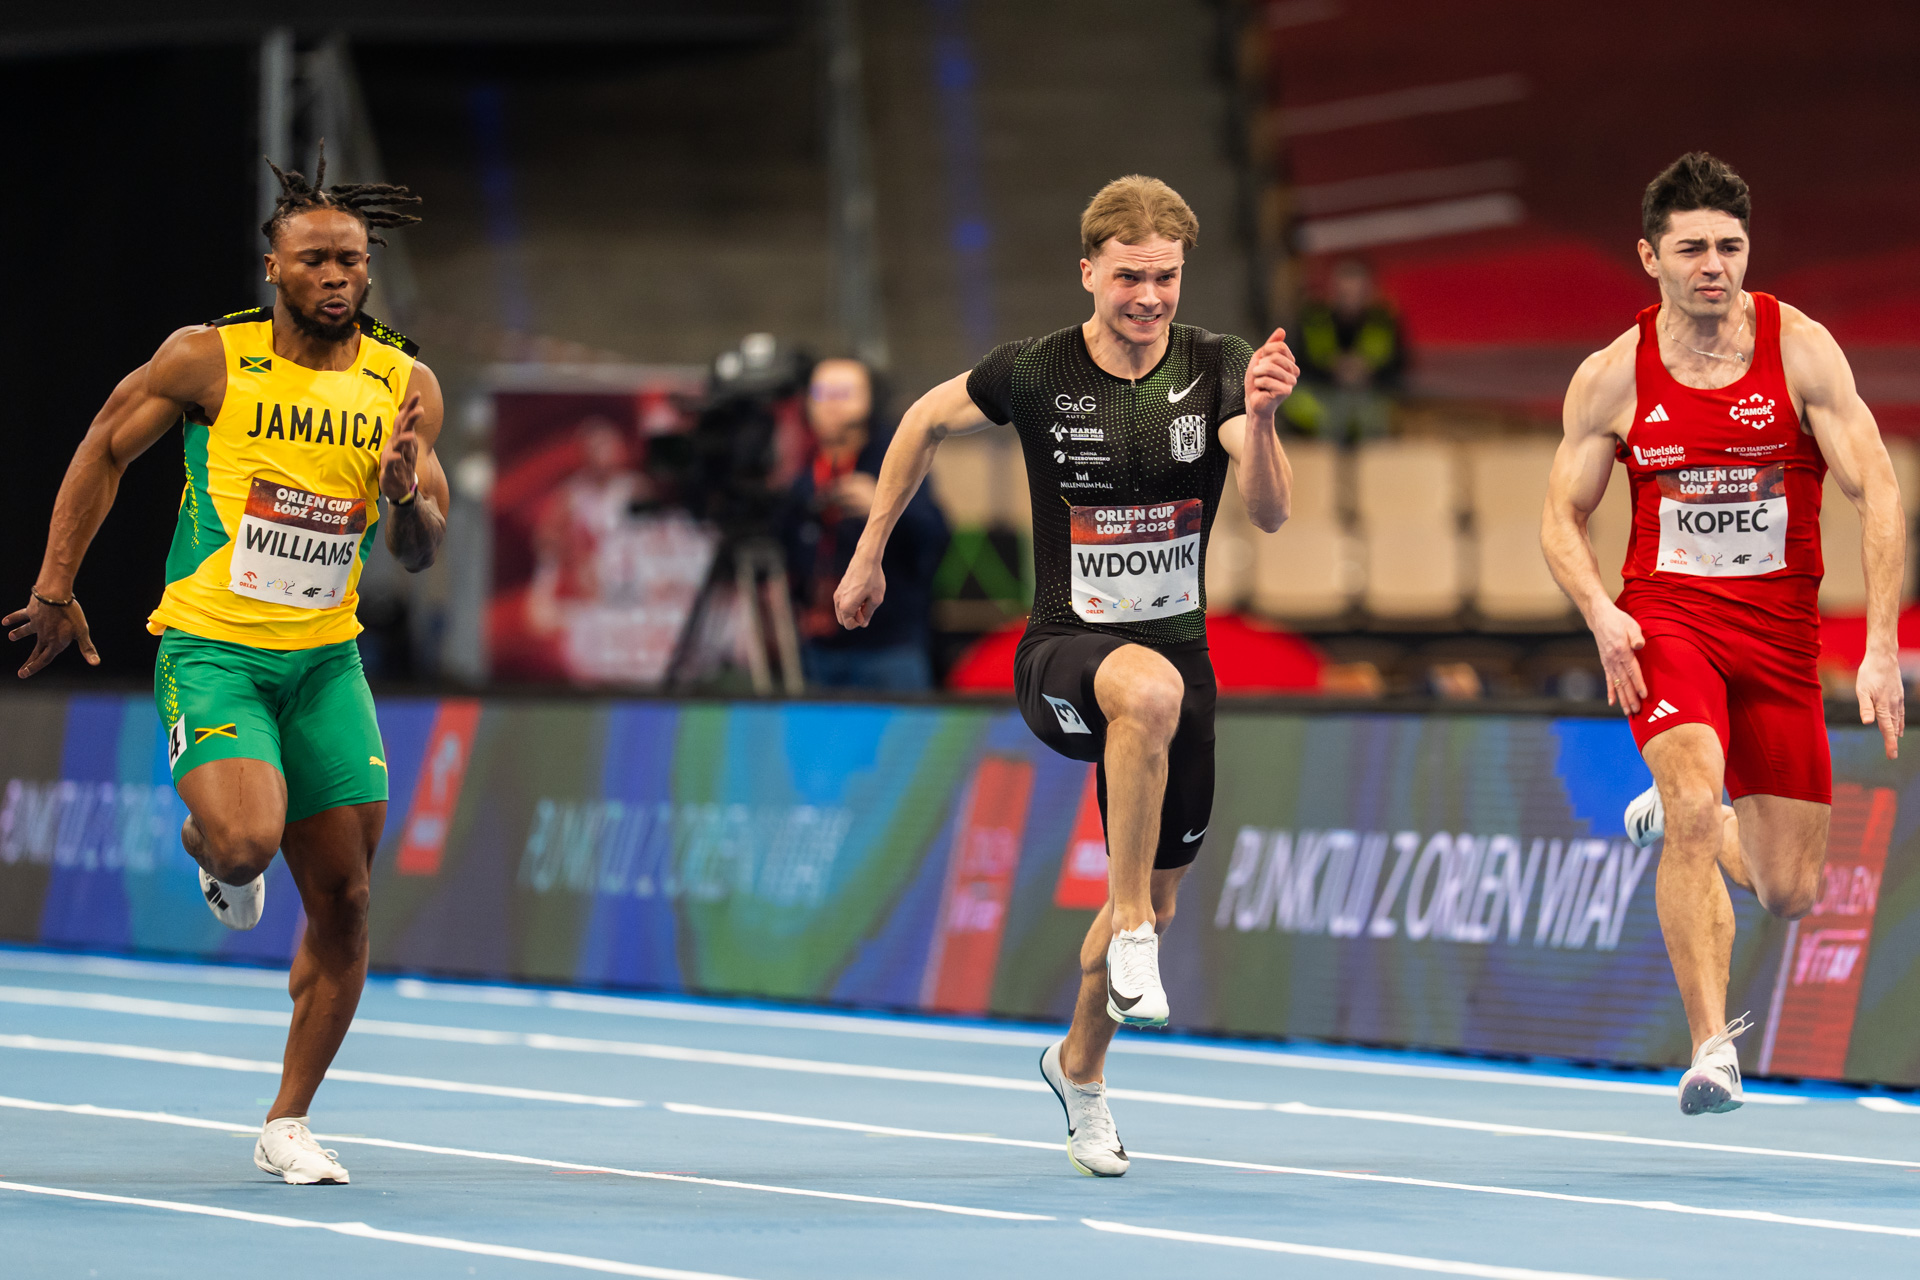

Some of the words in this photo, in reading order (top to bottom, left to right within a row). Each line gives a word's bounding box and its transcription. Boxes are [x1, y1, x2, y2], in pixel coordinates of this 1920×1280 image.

[1055, 394, 1097, 412] G&G
[1739, 405, 1773, 416] ZAMOŚĆ
[247, 402, 383, 451] JAMAICA
[1747, 444, 1777, 452] HARPOON
[1678, 469, 1726, 483] ORLEN
[1729, 468, 1757, 480] CUP
[1718, 482, 1758, 494] 2026
[276, 488, 326, 509] ORLEN
[327, 499, 352, 513] CUP
[311, 511, 349, 525] 2026
[1094, 509, 1146, 522] ORLEN
[1148, 505, 1176, 519] CUP
[1677, 502, 1769, 534] KOPEĆ
[1136, 520, 1176, 533] 2026
[246, 523, 355, 566] WILLIAMS
[1077, 541, 1195, 578] WDOWIK
[1732, 554, 1752, 565] 4F
[239, 581, 258, 590] ORLEN
[302, 587, 322, 598] 4F
[1151, 595, 1170, 607] 4F
[1054, 703, 1080, 724] 3
[171, 725, 180, 762] 4
[1405, 832, 1544, 946] ORLEN
[1533, 837, 1655, 951] VITAY
